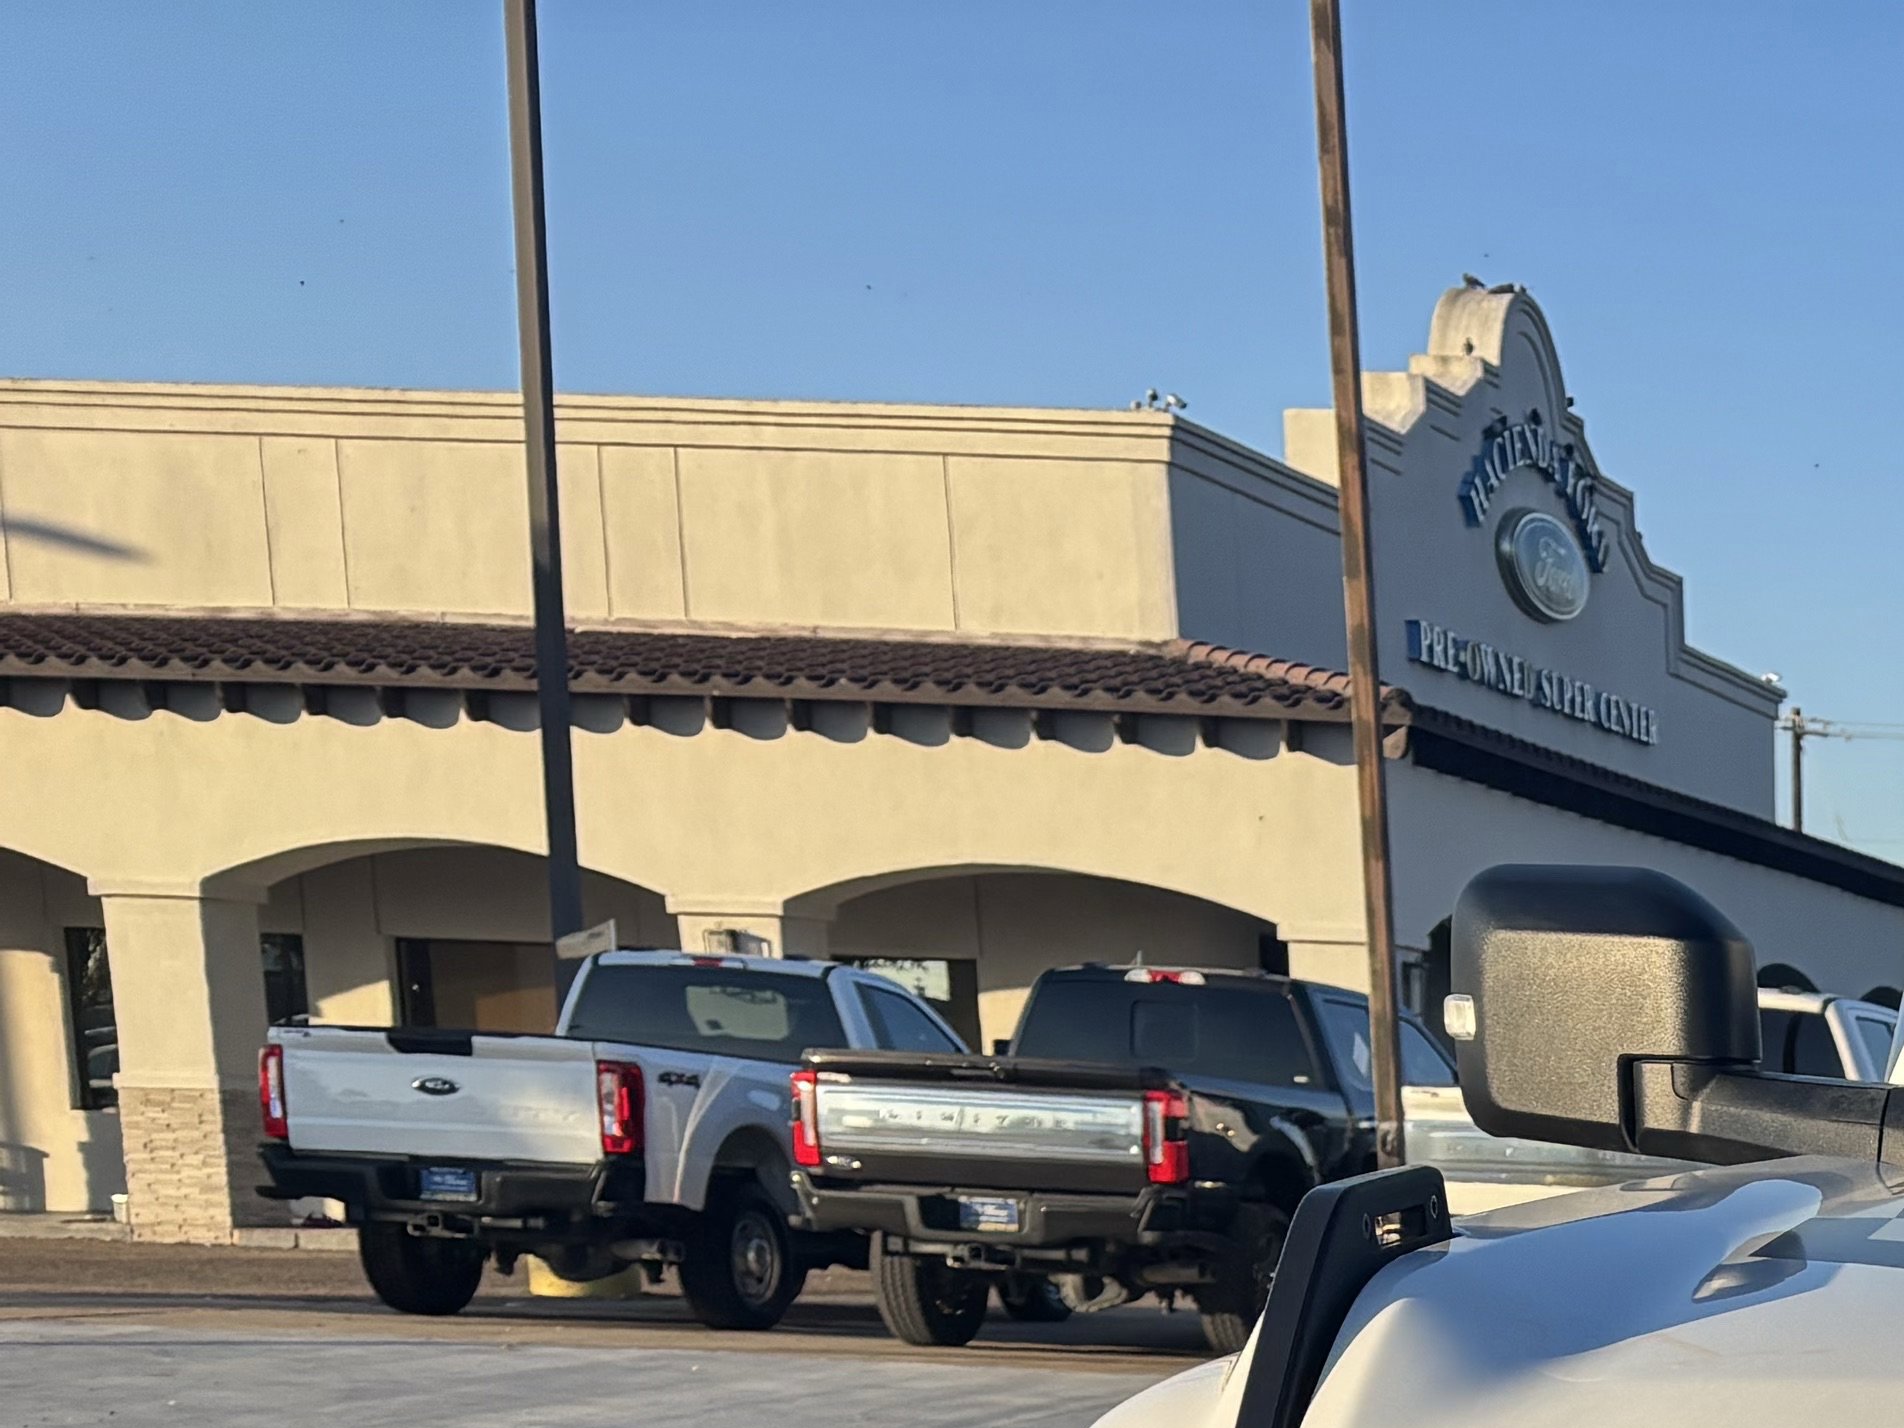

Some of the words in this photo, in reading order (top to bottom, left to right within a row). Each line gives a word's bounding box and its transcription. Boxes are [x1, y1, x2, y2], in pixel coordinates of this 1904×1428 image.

[1468, 422, 1563, 522] HACIENDA
[1565, 458, 1610, 573] FORD
[1418, 619, 1538, 700] PRE-OWNED
[1540, 669, 1598, 723] SUPER
[1600, 691, 1658, 744] CENTER
